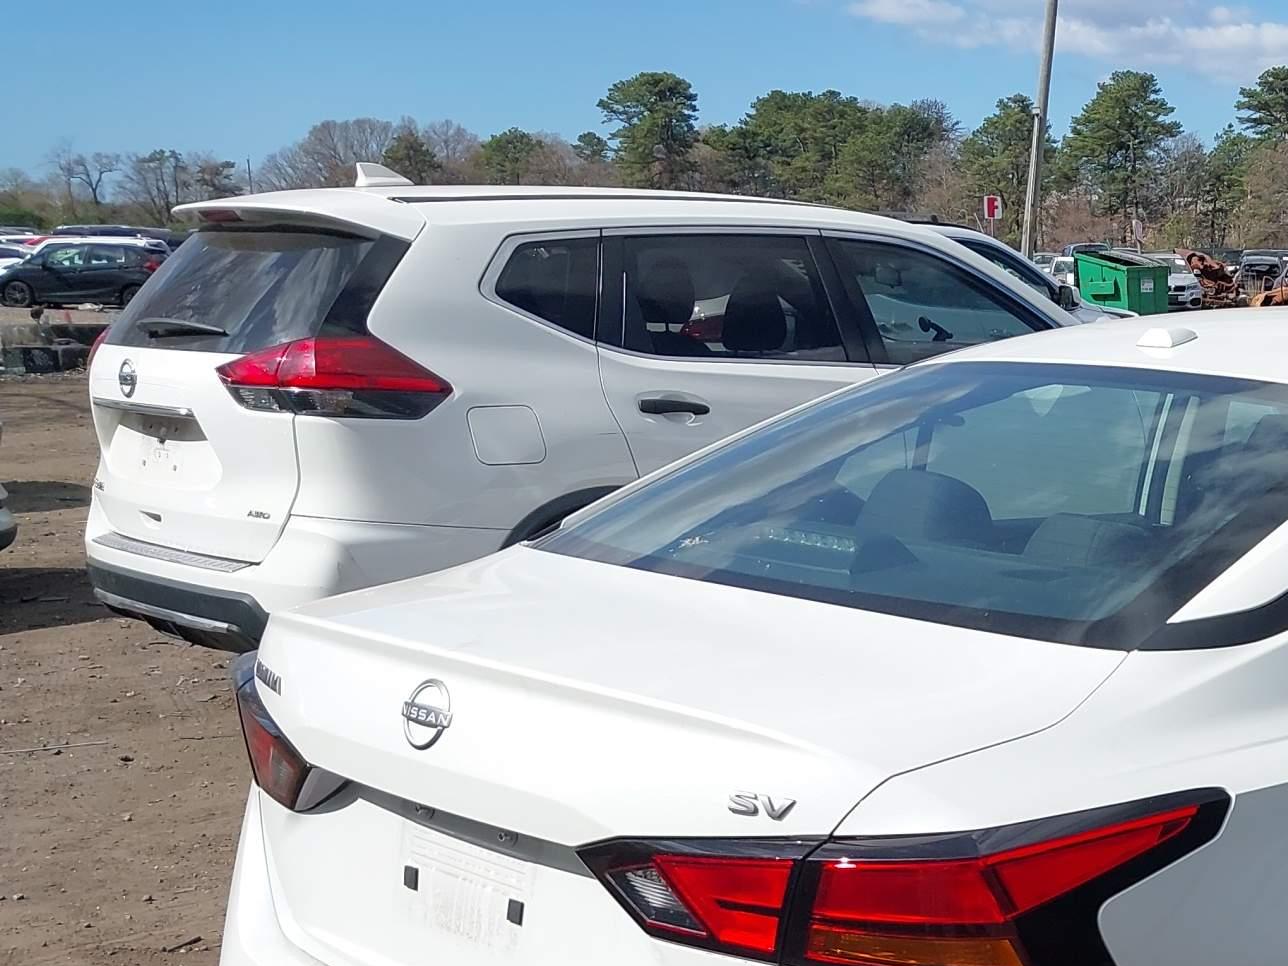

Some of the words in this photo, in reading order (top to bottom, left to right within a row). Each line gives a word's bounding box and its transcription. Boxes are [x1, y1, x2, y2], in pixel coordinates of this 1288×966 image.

[987, 197, 999, 217] F
[402, 702, 453, 728] NISSAN
[728, 791, 797, 822] SV
